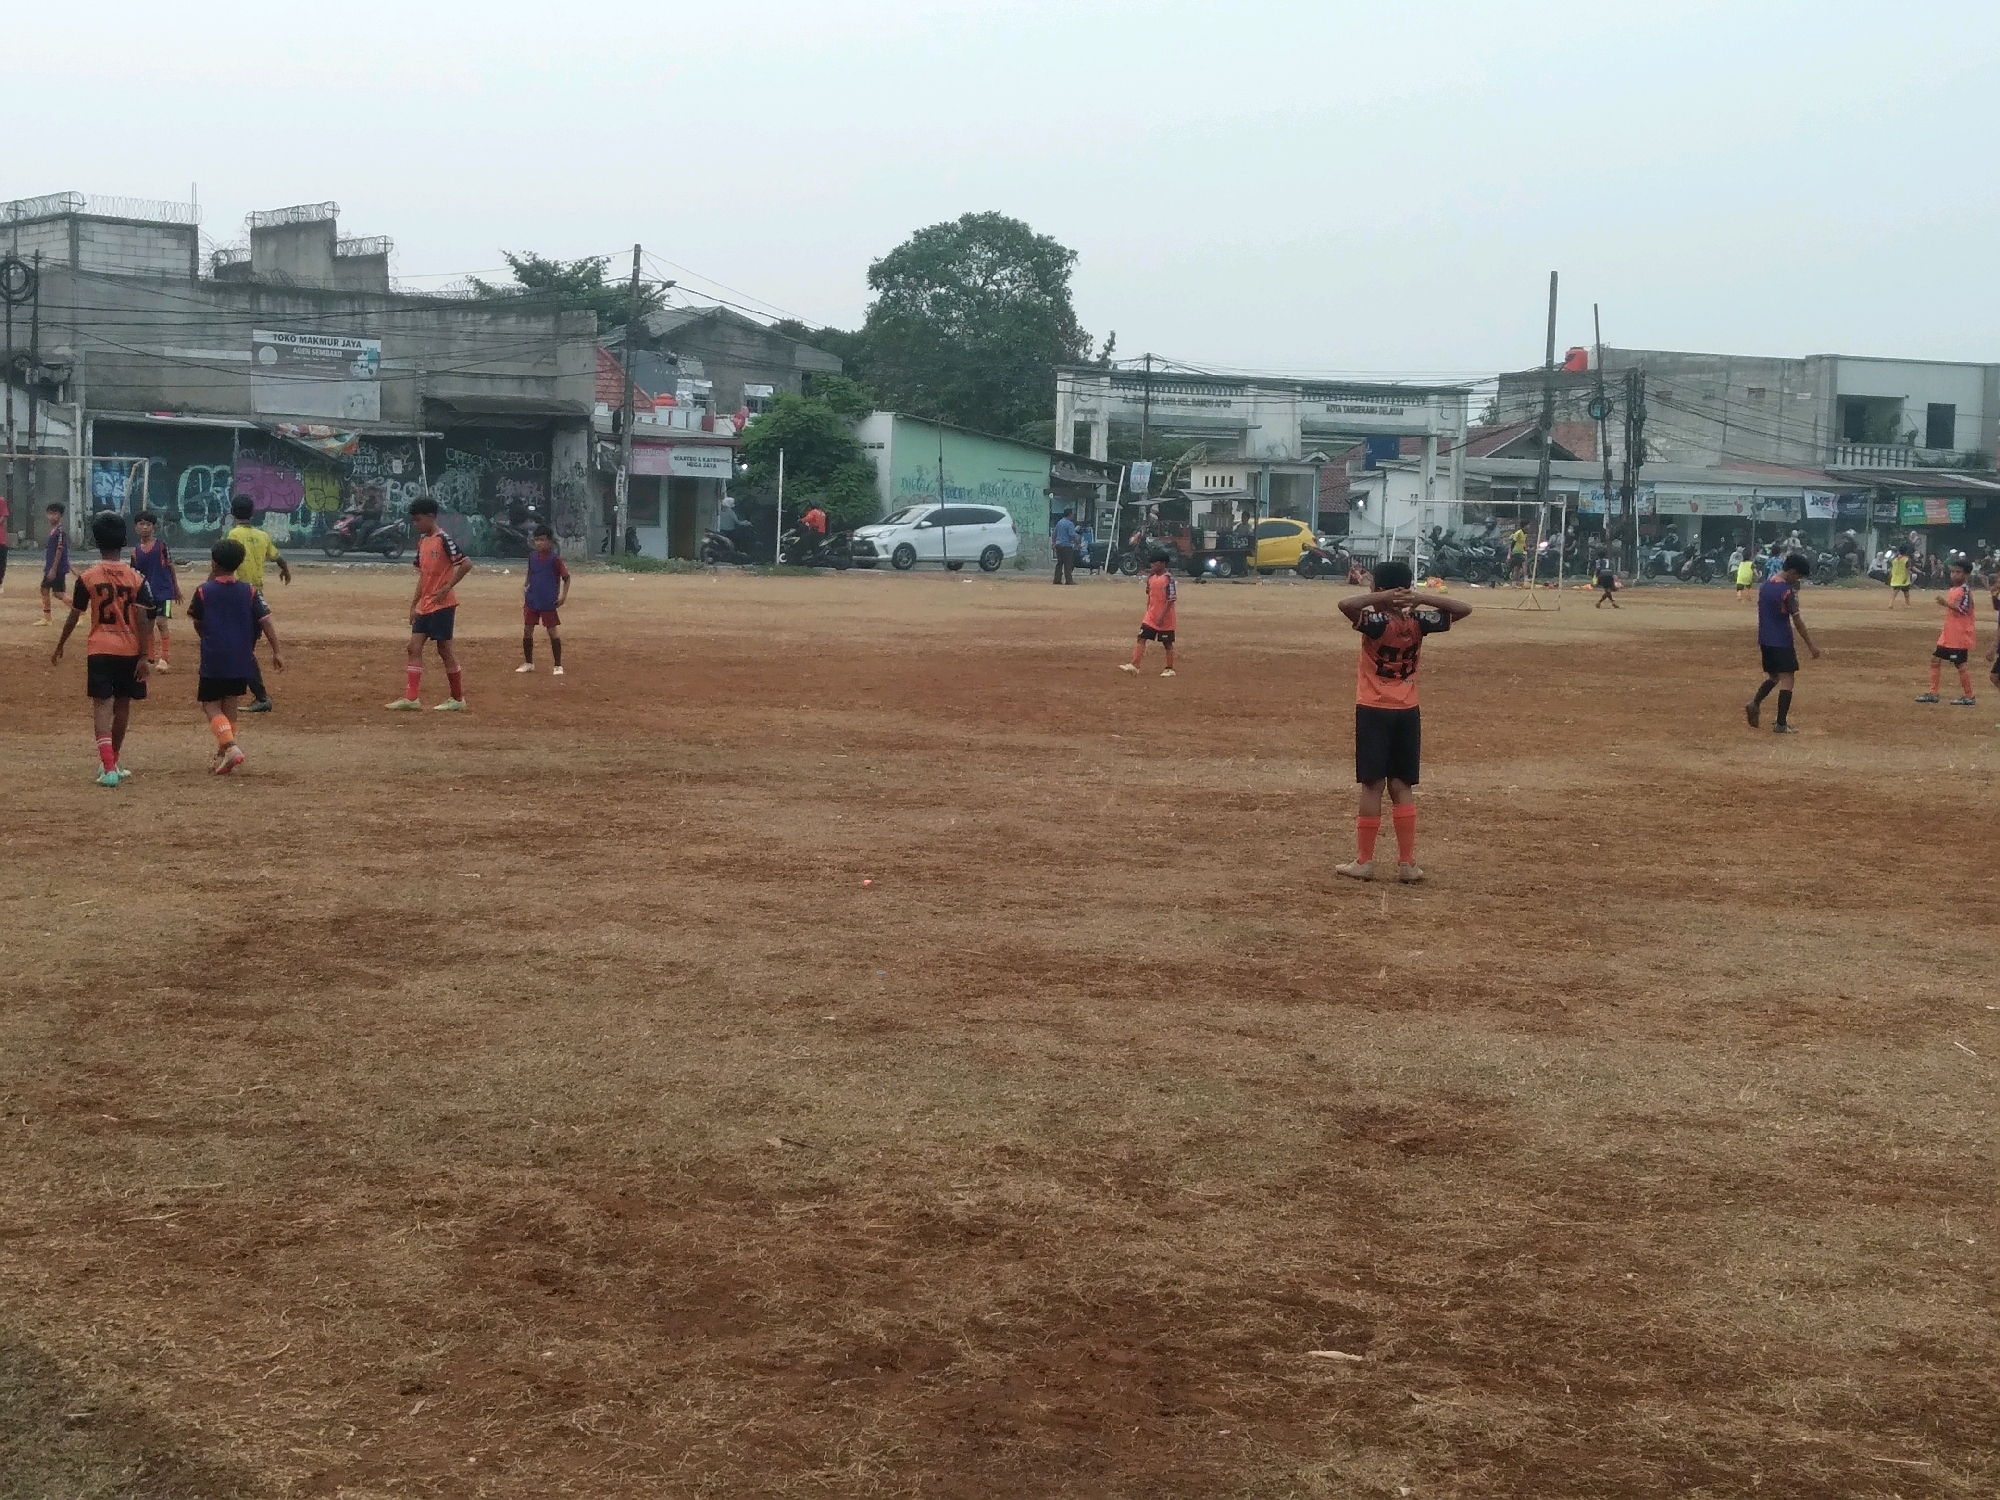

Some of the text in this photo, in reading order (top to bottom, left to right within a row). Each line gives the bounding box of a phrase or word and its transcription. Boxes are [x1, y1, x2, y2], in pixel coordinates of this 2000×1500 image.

[272, 333, 362, 349] TOKO MAKMUR JAYA
[292, 347, 310, 356] AGEN
[1326, 404, 1342, 414] KOTA
[673, 455, 698, 463] WARTEG
[702, 462, 717, 470] JAYA
[94, 582, 132, 625] 27
